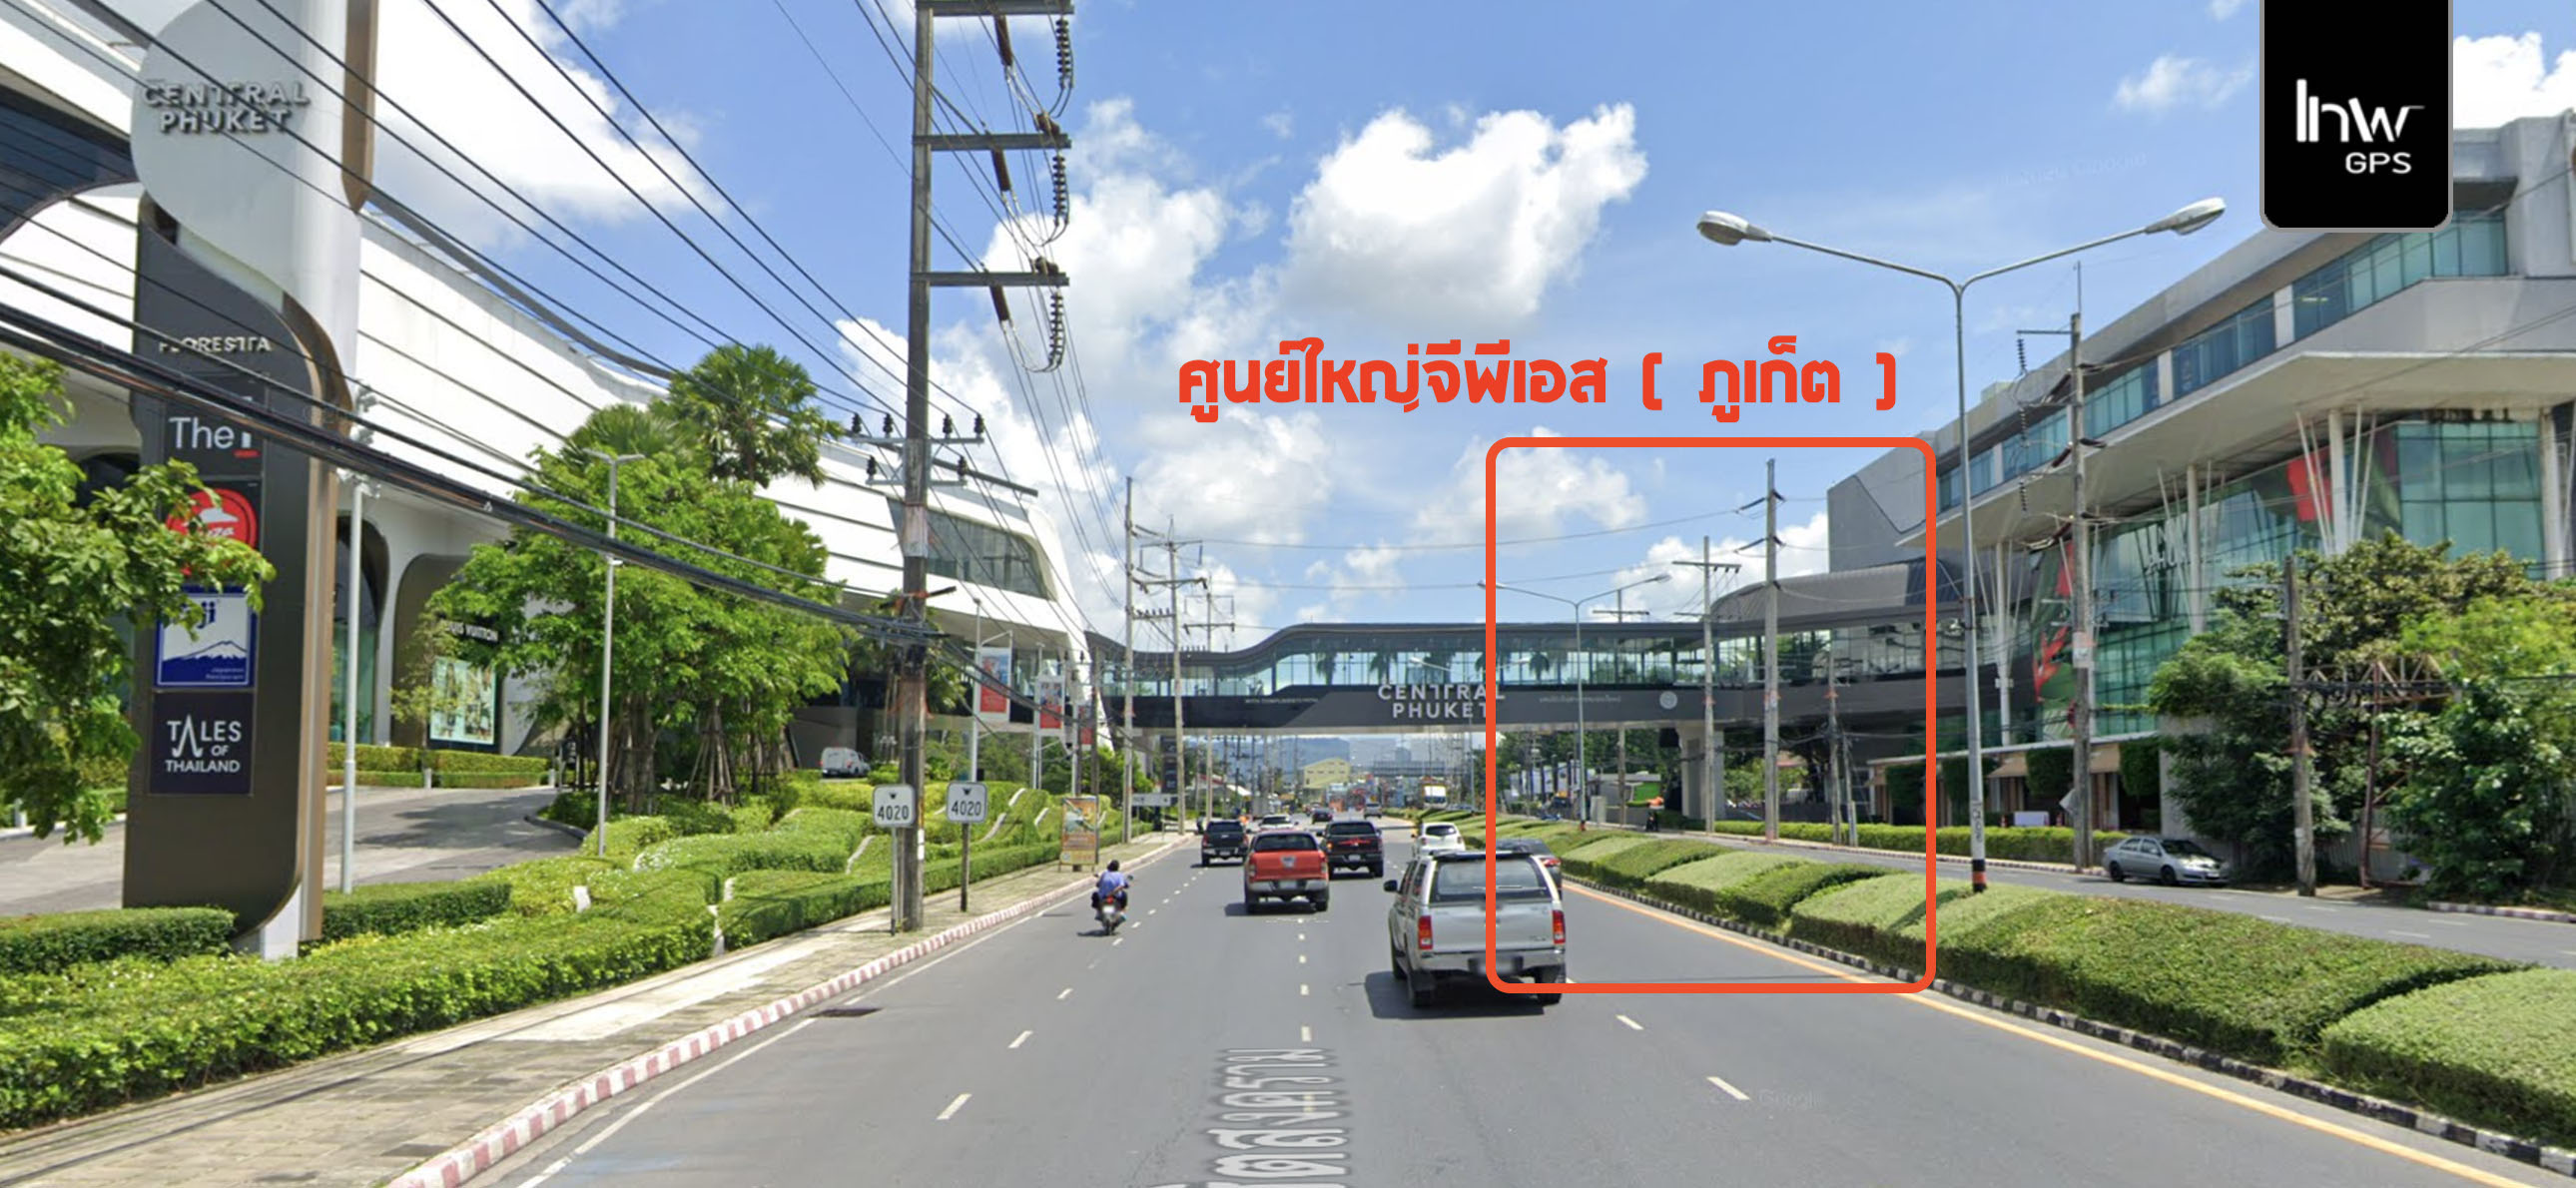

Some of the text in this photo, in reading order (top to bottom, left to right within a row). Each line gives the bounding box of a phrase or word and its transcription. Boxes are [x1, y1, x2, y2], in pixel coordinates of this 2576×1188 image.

[144, 81, 311, 107] CENTRAL
[161, 108, 293, 134] PHUKET
[1377, 683, 1506, 700] CENTRAL
[1393, 702, 1487, 718] PHUKET
[167, 714, 242, 758] TALES
[211, 745, 230, 757] OF
[165, 760, 241, 773] THAILAND
[878, 800, 982, 821] 4020 4020
